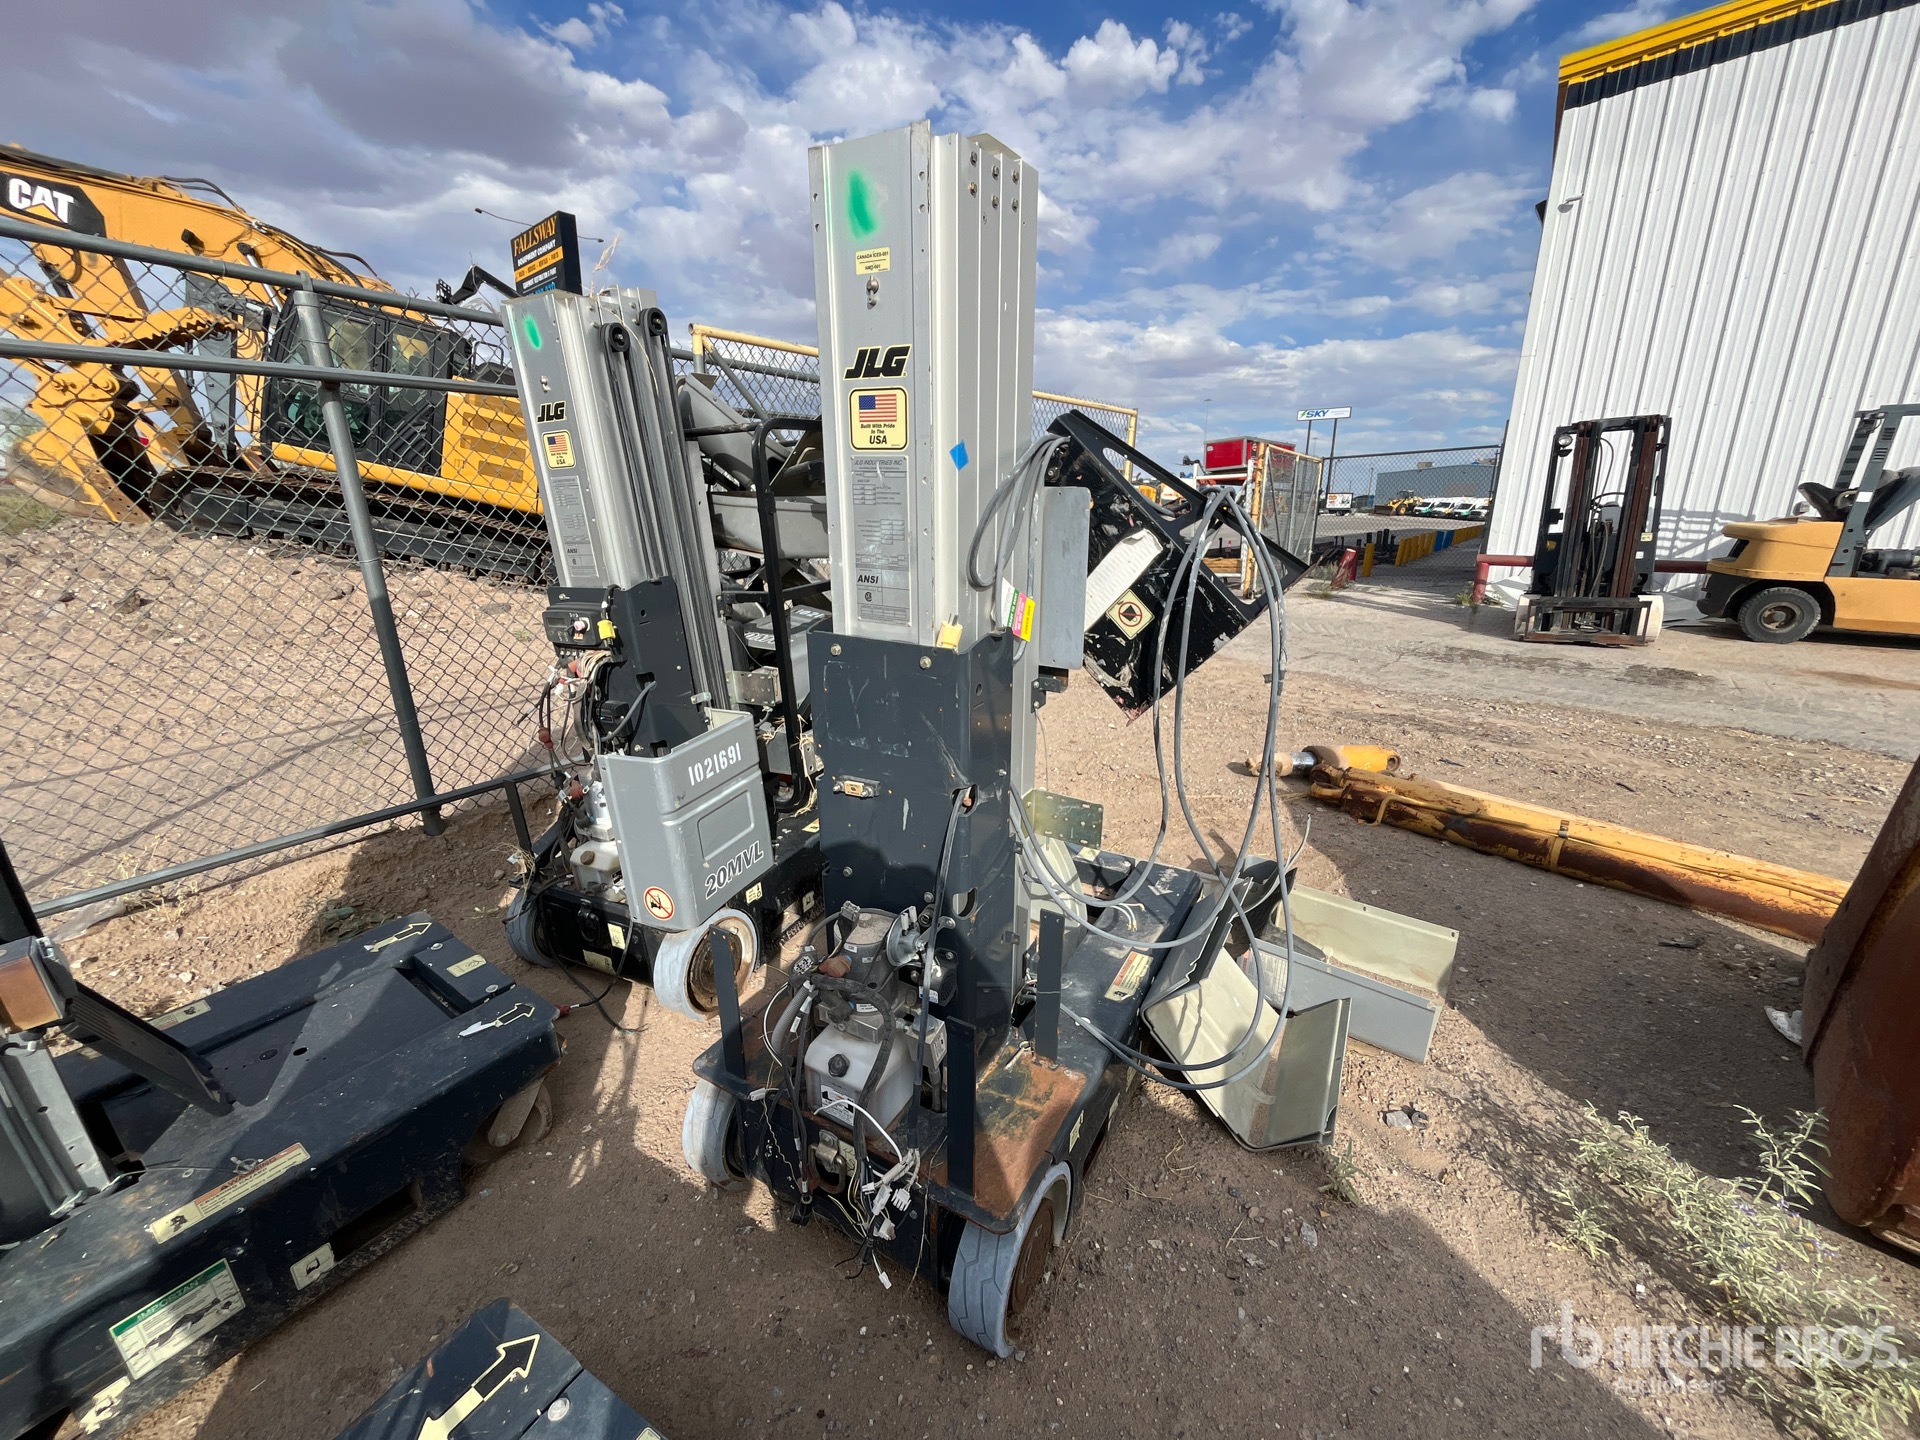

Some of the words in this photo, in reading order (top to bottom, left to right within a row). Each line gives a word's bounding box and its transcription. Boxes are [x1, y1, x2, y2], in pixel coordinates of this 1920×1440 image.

[8, 177, 74, 224] CAT
[513, 215, 557, 257] FALLSWAY
[844, 345, 911, 379] JLG
[536, 401, 566, 423] JLG
[1306, 410, 1330, 418] SKY
[869, 435, 887, 444] USA
[857, 574, 879, 584] ANSI
[688, 741, 742, 787] 1021691
[704, 840, 765, 900] 20MVL
[137, 1277, 205, 1321] IMPORTAN
